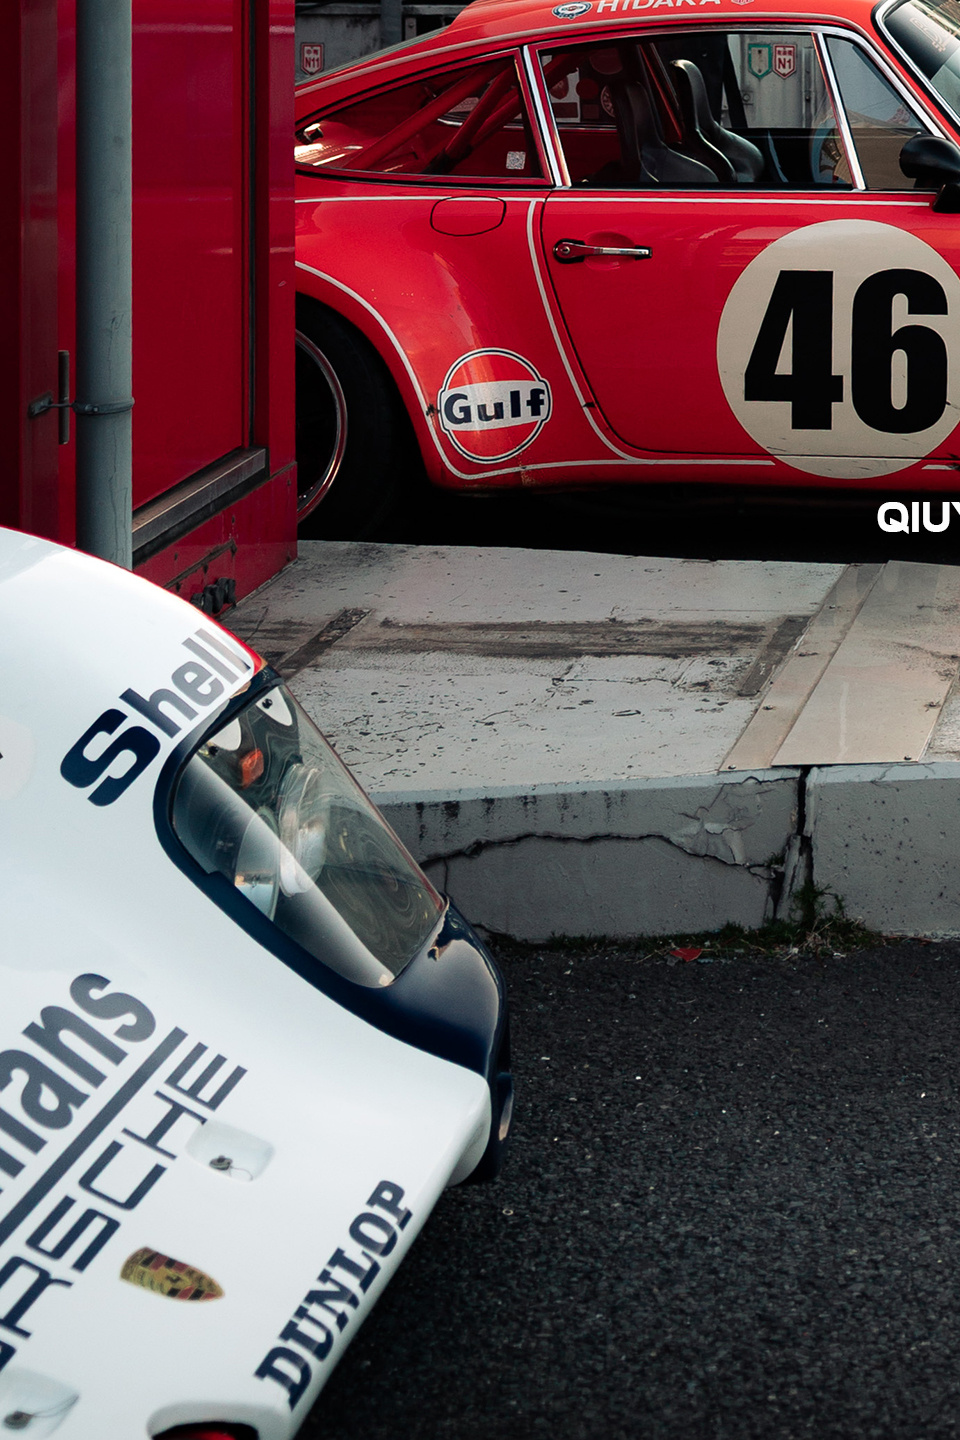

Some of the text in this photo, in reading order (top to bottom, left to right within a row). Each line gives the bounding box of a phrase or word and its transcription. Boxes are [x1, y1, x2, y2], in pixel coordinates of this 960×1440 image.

[778, 58, 791, 69] N1
[444, 388, 545, 425] Gulf
[744, 268, 949, 434] 46
[60, 628, 251, 807] Shell
[0, 1042, 249, 1371] RSCHE
[253, 1179, 413, 1412] DUNLOP
